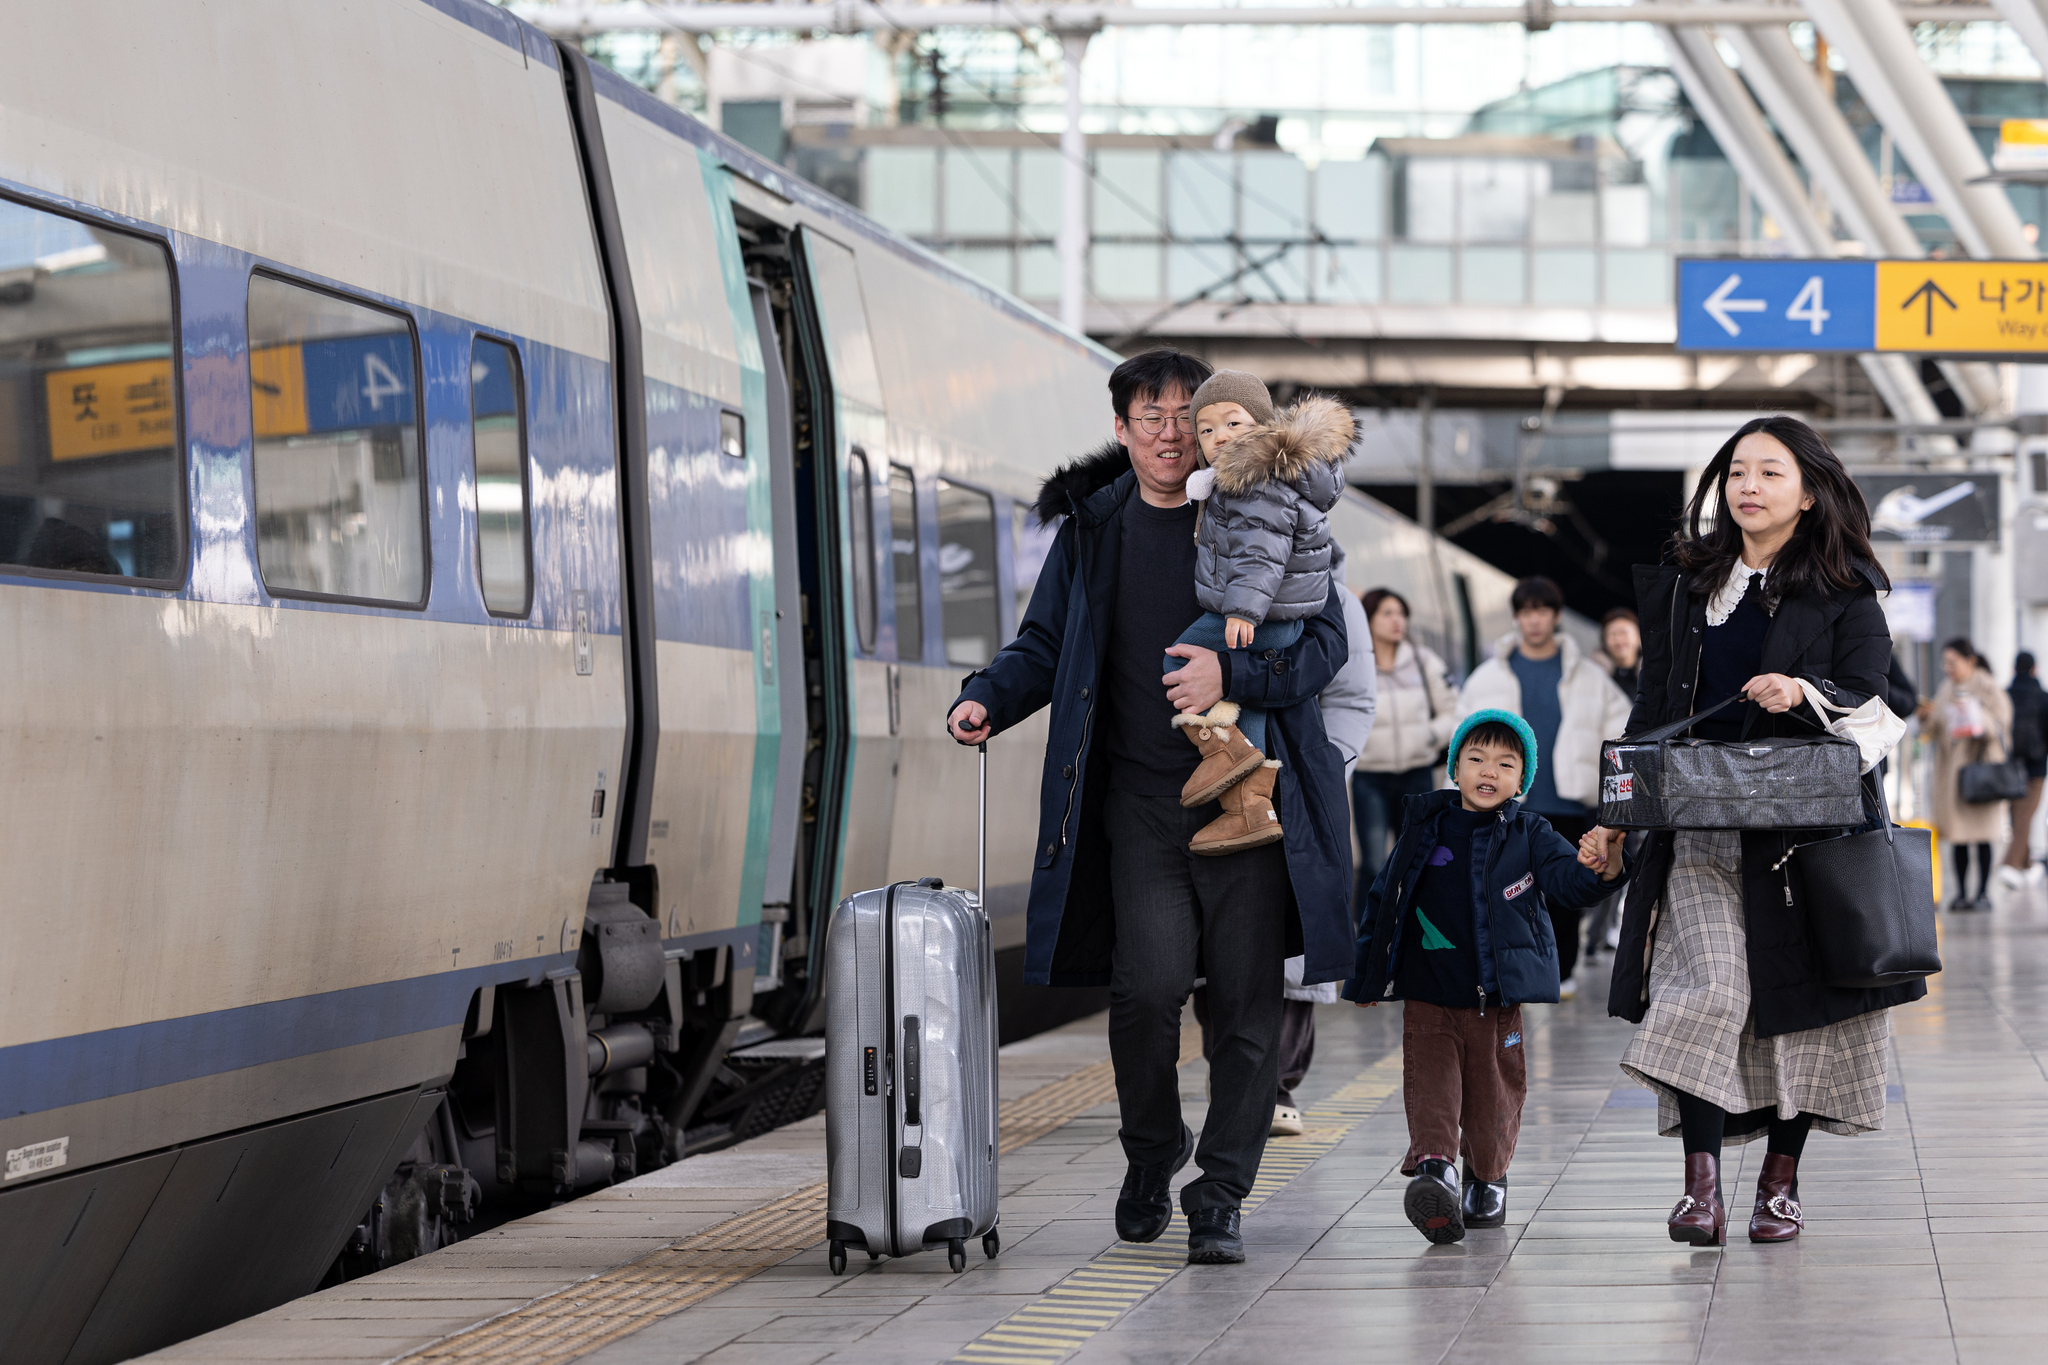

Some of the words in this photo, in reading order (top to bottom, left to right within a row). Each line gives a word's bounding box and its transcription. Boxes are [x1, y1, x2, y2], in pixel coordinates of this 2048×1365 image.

[1786, 276, 1831, 336] 4
[1997, 319, 2037, 341] Way
[577, 614, 588, 648] 16
